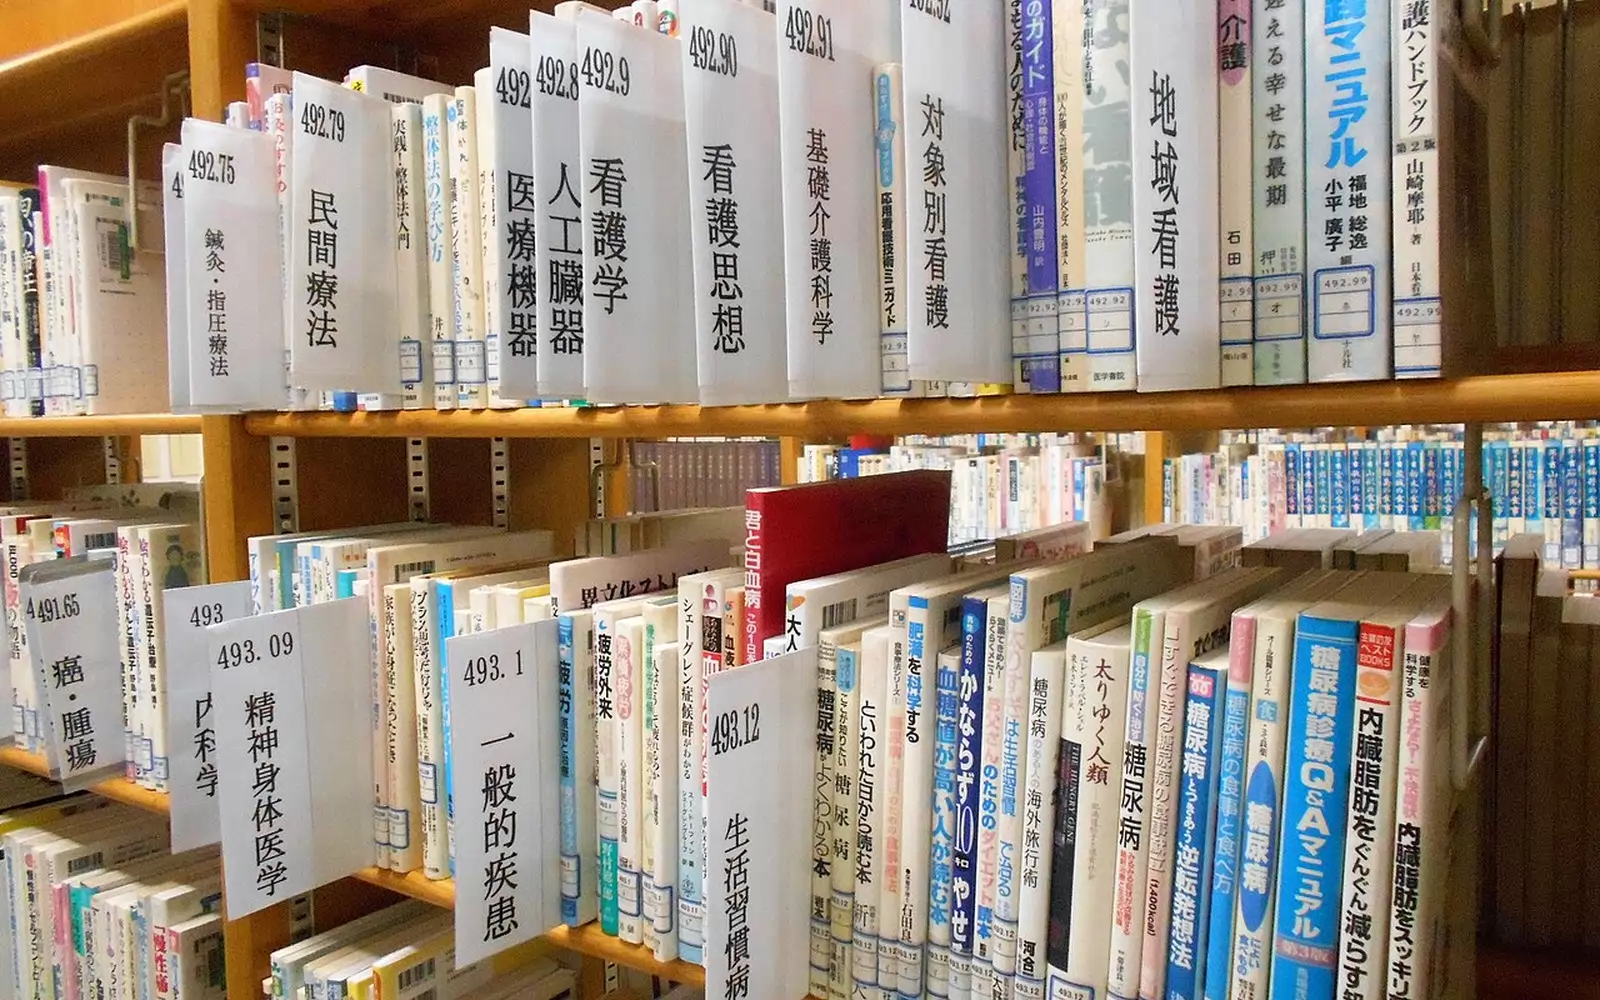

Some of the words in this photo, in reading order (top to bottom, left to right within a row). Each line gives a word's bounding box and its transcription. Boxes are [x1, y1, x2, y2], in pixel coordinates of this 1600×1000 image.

[536, 55, 579, 101] 492.8
[581, 46, 630, 97] 492.9
[689, 25, 738, 78] 492.90
[785, 6, 835, 62] 492.91
[1026, 1, 1046, 88] のガイド
[188, 149, 235, 185] 492.75
[301, 102, 345, 143] 492.79
[425, 115, 443, 262] 整体法の学び方
[920, 93, 949, 329] 対象別看護
[1149, 70, 1180, 336] 地域看護
[1325, 179, 1343, 211] 小平
[307, 189, 338, 348] 民間療法
[507, 170, 537, 357] 医療機器
[548, 162, 583, 356] 人工臓器
[589, 157, 629, 315] 看護学
[702, 143, 745, 354] 看護思想
[806, 128, 834, 345] 基礎介護科学
[1228, 231, 1241, 265] 石田
[204, 228, 229, 377] 鍼灸・指圧療法
[1259, 283, 1298, 293] 492.99
[1324, 276, 1368, 288] 492.99
[1093, 372, 1126, 381] 医学書院
[38, 593, 80, 623] 491.65
[190, 603, 223, 628] 493
[787, 615, 801, 651] 大人
[464, 650, 524, 688] 493.1
[598, 633, 613, 719] 疲労外来
[906, 622, 924, 744] 肥満を科学する
[1359, 653, 1391, 667] BOOKS
[52, 655, 97, 772] 癌・腫瘍
[711, 703, 760, 755] 493.12
[1086, 658, 1115, 786] 太りゆく人類
[244, 691, 288, 897] 精神身体医学
[480, 731, 520, 942] 一般的疾患
[833, 773, 851, 860] 糖尿病
[856, 701, 876, 884] といわれた日から読む本
[1119, 741, 1147, 851] 糖尿病
[1243, 800, 1273, 895] 糖尿病
[724, 813, 751, 1000] 生活習慣病
[1388, 822, 1421, 1000] 内臓脂肪をスッキリ
